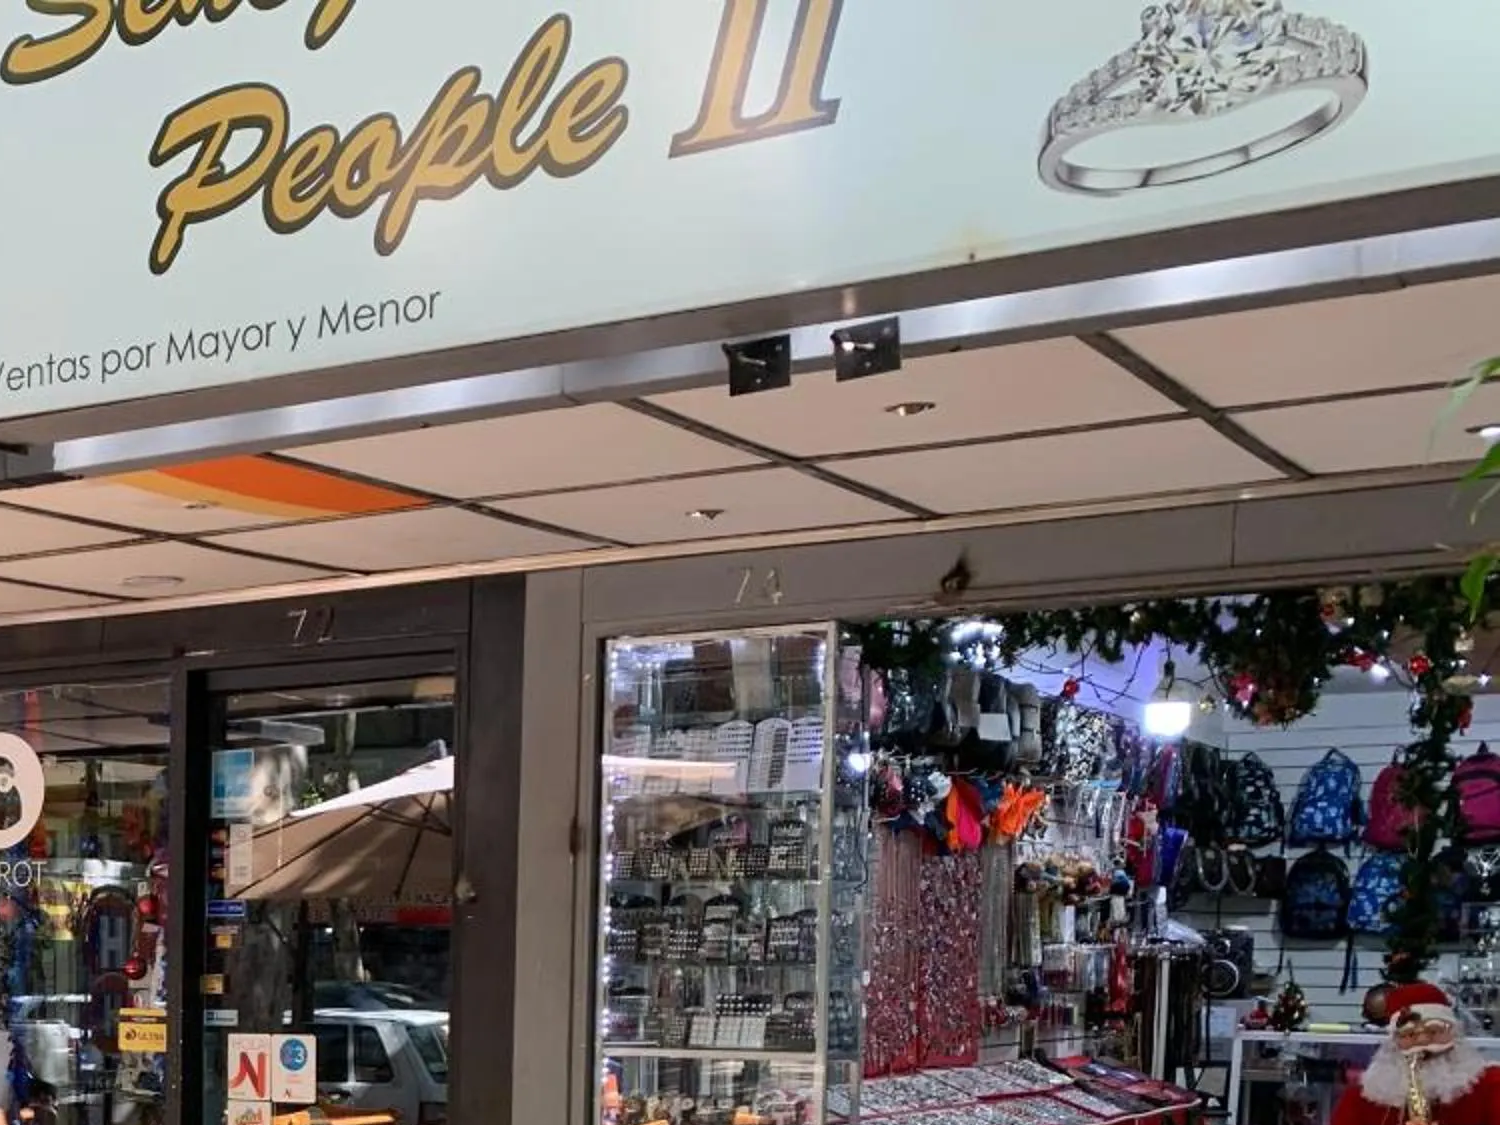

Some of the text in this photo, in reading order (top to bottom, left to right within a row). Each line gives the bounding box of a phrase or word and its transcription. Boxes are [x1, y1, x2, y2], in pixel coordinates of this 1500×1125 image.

[148, 11, 628, 275] People
[101, 339, 159, 384] por
[165, 319, 278, 365] Mayor
[286, 314, 307, 352] y
[316, 289, 442, 339] Menor
